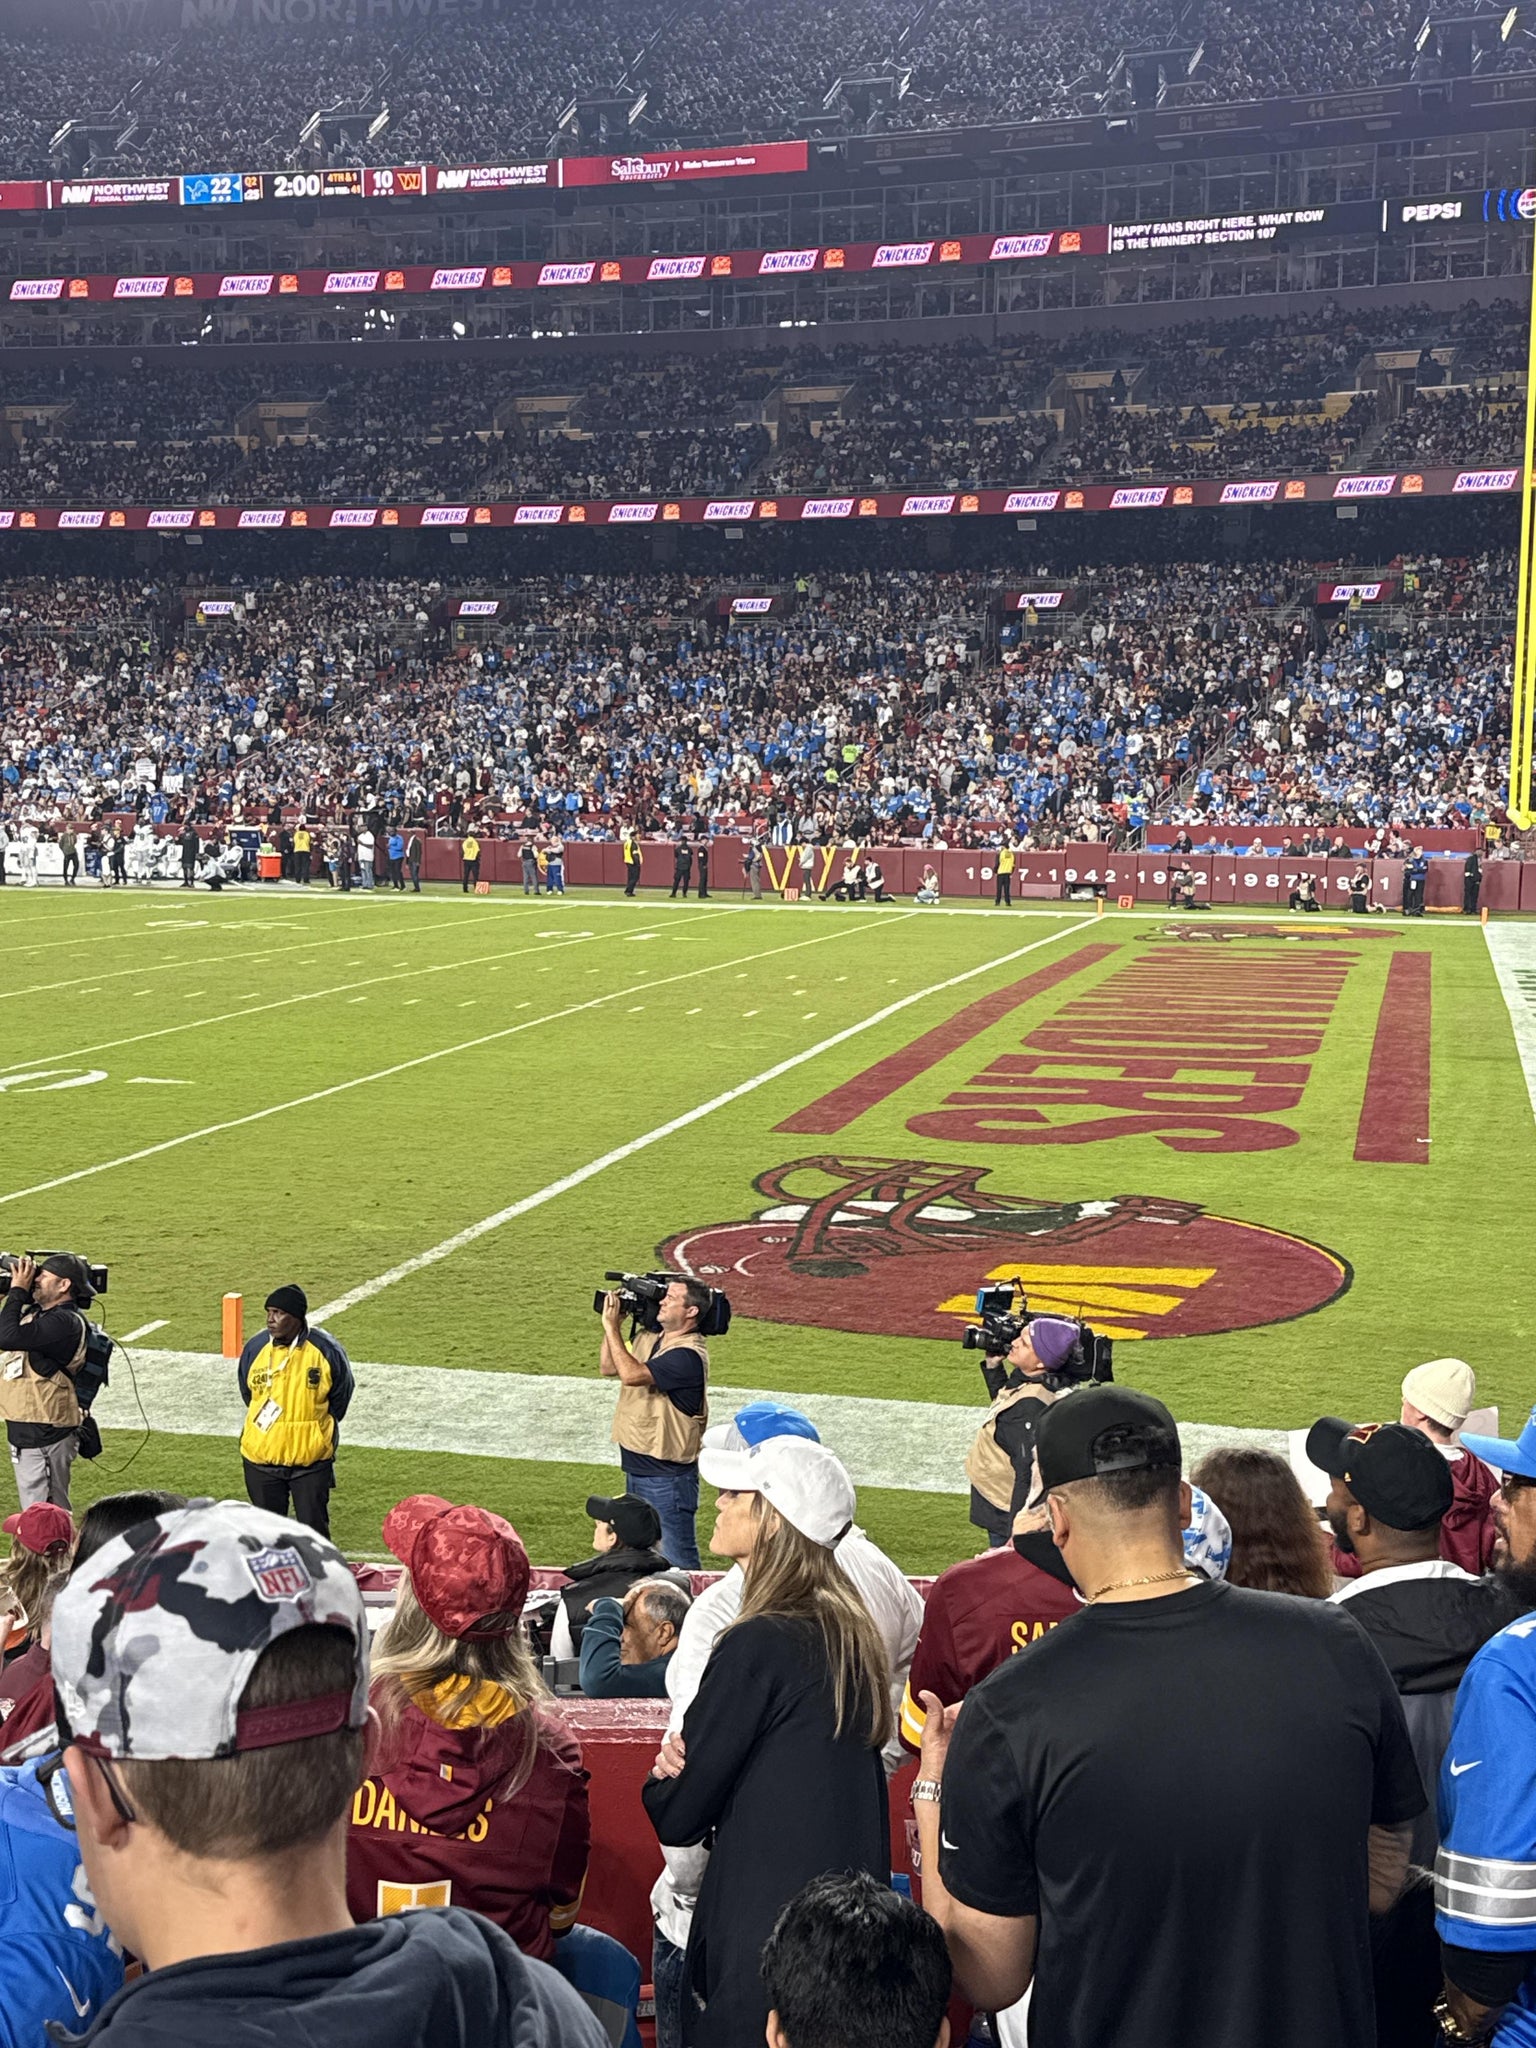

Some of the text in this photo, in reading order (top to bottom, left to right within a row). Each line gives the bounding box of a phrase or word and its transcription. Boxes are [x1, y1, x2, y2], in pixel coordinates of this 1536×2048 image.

[611, 157, 672, 178] Salisbury
[372, 170, 394, 188] 10
[436, 165, 548, 189] NW NORTHWEST
[61, 183, 170, 203] NW NORTHWEST
[210, 177, 232, 195] 22
[273, 175, 321, 197] 2:00
[1402, 202, 1462, 222] PEPSI
[1113, 225, 1152, 237] HAPPY
[1153, 222, 1183, 234] FANS
[1185, 219, 1221, 232] RIGHT
[1259, 213, 1294, 226] WHAT
[1295, 210, 1324, 222] ROW
[993, 237, 1050, 256] SNICKERS
[1113, 227, 1277, 250] IS THE WINNER? SECTION 107
[762, 252, 816, 270] SNICKERS
[876, 246, 932, 264] SNICKERS
[434, 266, 483, 283] SNICKERS
[541, 264, 593, 282] SNICKERS
[651, 260, 702, 277] SNICKERS
[117, 278, 164, 293] SNICKERS
[222, 277, 270, 291] SNICKERS
[327, 271, 376, 288] SNICKERS
[14, 282, 60, 296] SNICKERS
[1338, 478, 1392, 494] SNICKERS
[1457, 473, 1513, 490] SNICKERS
[1114, 488, 1167, 505] SNICKERS
[1224, 484, 1278, 500] SNICKERS
[707, 501, 753, 516] SNICKERS
[805, 503, 852, 515] SNICKERS
[905, 498, 954, 513] SNICKERS
[1008, 495, 1057, 509] SNICKERS
[61, 513, 101, 525] SNICKERS
[150, 512, 192, 525] SNICKERS
[241, 511, 284, 525] SNICKERS
[332, 510, 376, 523] SNICKERS
[424, 509, 468, 522] SNICKERS
[517, 508, 561, 522] SNICKERS
[611, 503, 657, 520] SNICKERS
[475, 881, 489, 893] 20
[966, 867, 1027, 881] 197
[1049, 868, 1116, 882] 1942
[1229, 873, 1299, 888] 1987
[1321, 874, 1389, 891] 191
[785, 889, 798, 901] 10
[1121, 897, 1130, 908] G
[260, 1567, 305, 1594] NFL
[1011, 1621, 1059, 1655] SA
